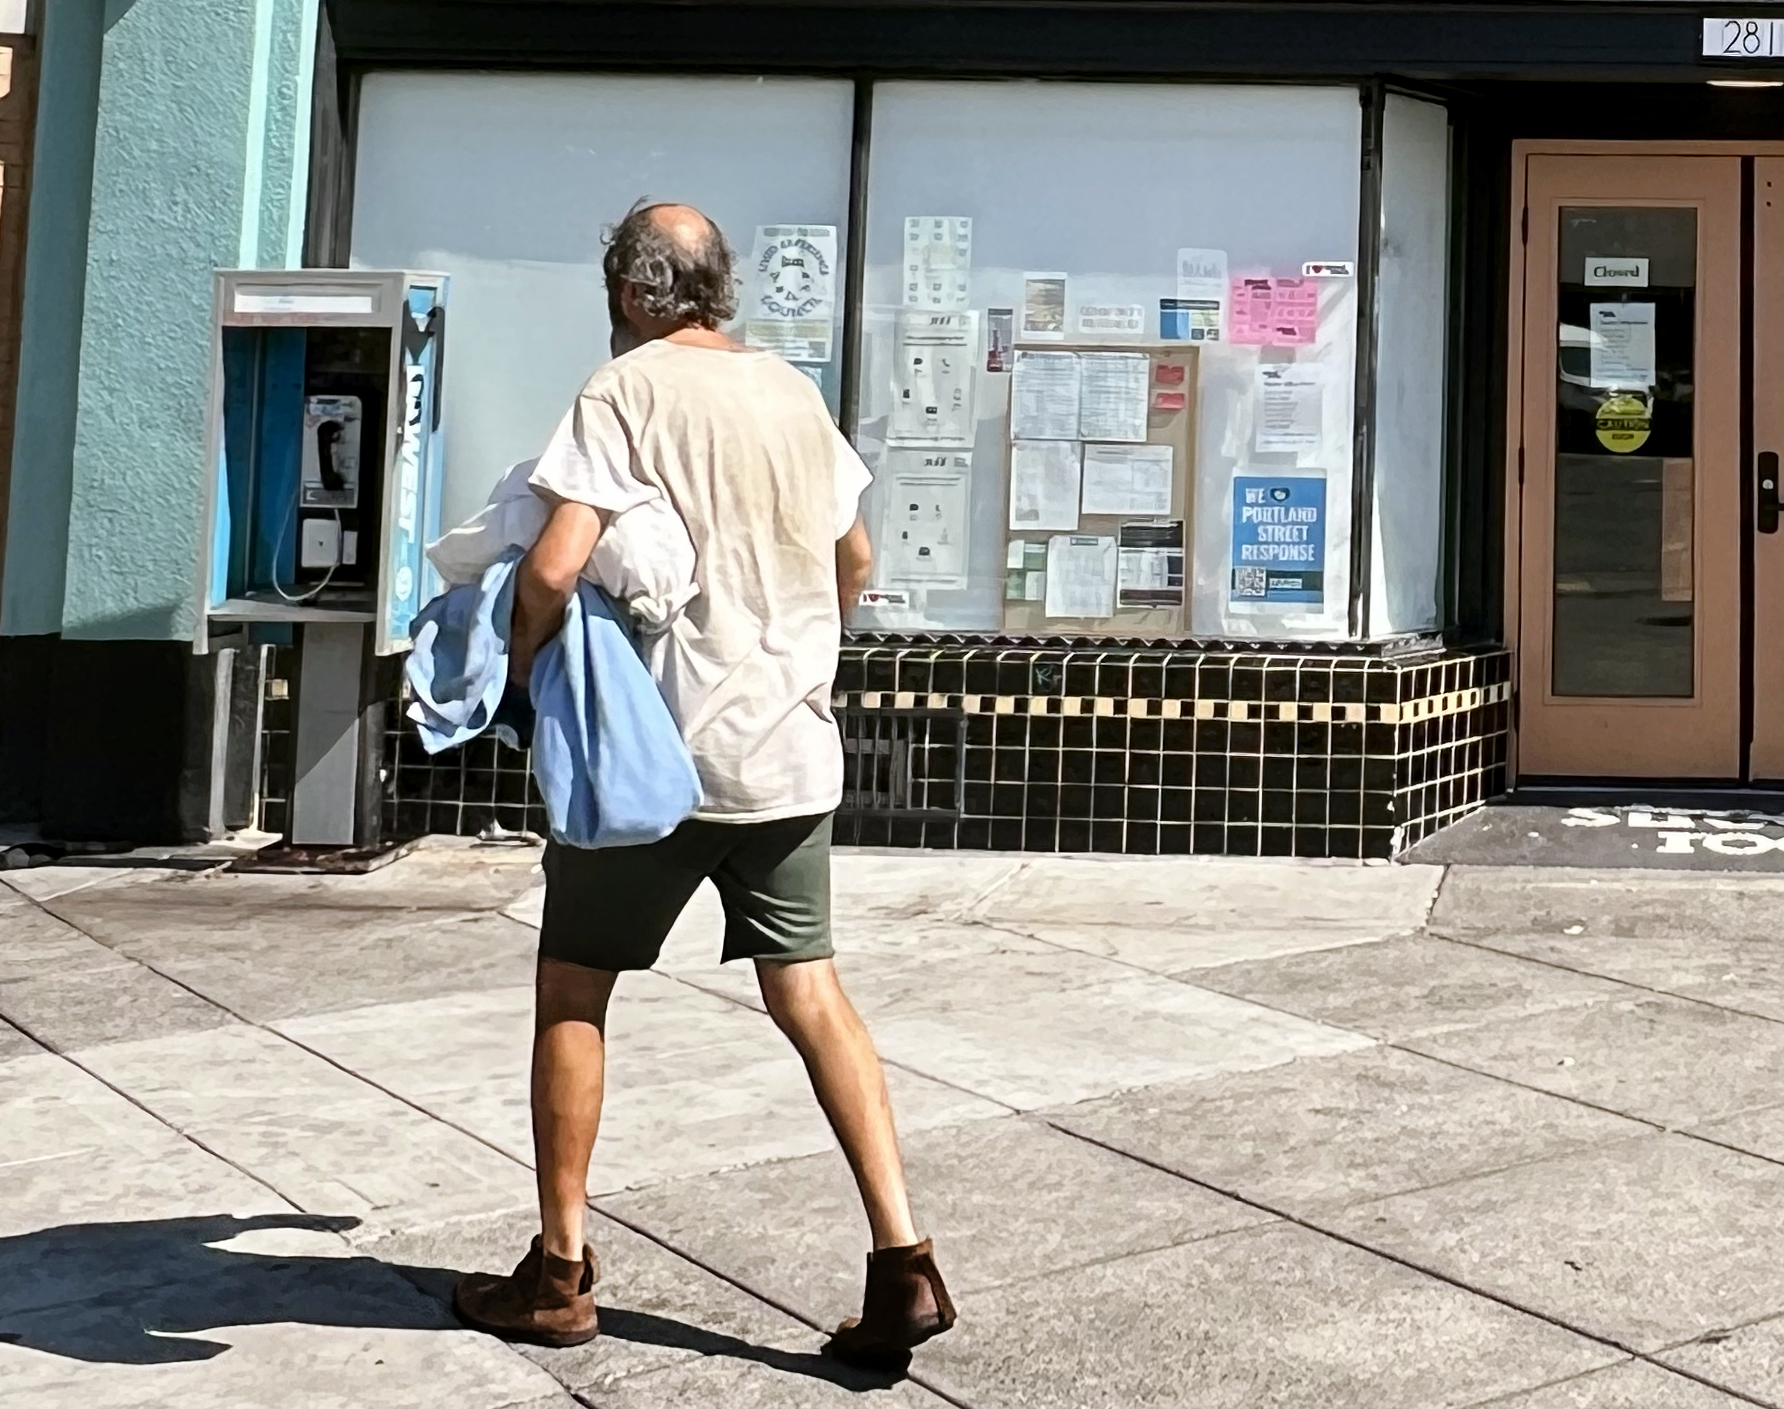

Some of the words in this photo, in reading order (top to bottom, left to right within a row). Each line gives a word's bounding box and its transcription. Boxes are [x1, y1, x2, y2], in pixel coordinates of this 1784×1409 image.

[1722, 20, 1774, 56] 281
[1245, 488, 1265, 504] WE
[1242, 506, 1318, 523] PORTLAND
[1257, 526, 1309, 542] STREET
[1241, 545, 1316, 561] RESPONSE
